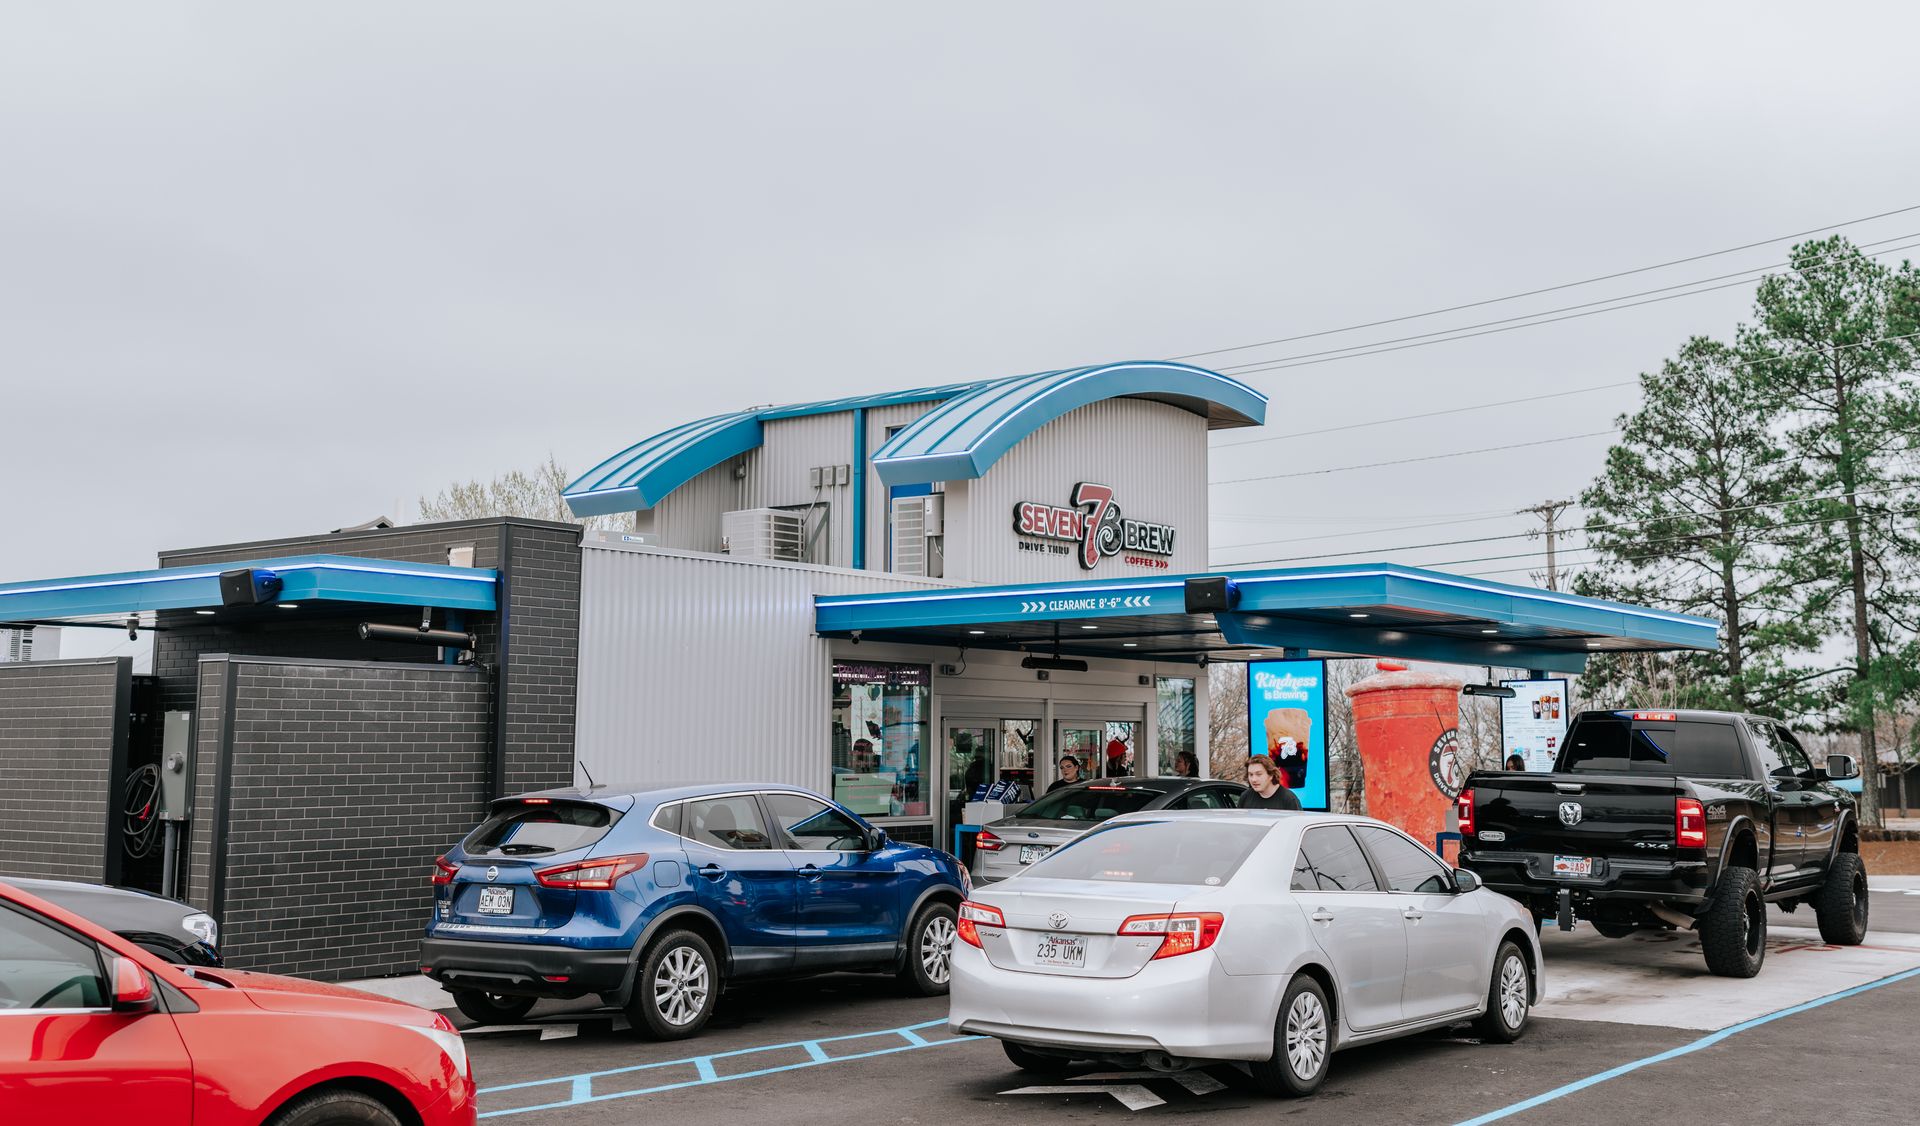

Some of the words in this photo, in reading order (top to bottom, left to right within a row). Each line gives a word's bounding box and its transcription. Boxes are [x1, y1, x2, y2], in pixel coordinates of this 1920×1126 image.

[1018, 502, 1083, 541] SEVEN
[1124, 519, 1175, 555] BREW
[1019, 541, 1045, 553] DRIVE
[1047, 544, 1070, 555] THRU
[1124, 556, 1154, 567] COFFEE
[1048, 598, 1096, 612] CLEARANCE
[1255, 671, 1317, 691] Kindness
[1263, 689, 1272, 701] is
[1272, 689, 1309, 703] Brewing
[1574, 862, 1591, 873] ABY
[479, 895, 495, 908] AEM
[1047, 935, 1077, 946] Arkansas
[1037, 943, 1058, 959] 235
[1063, 945, 1084, 961] UKM
